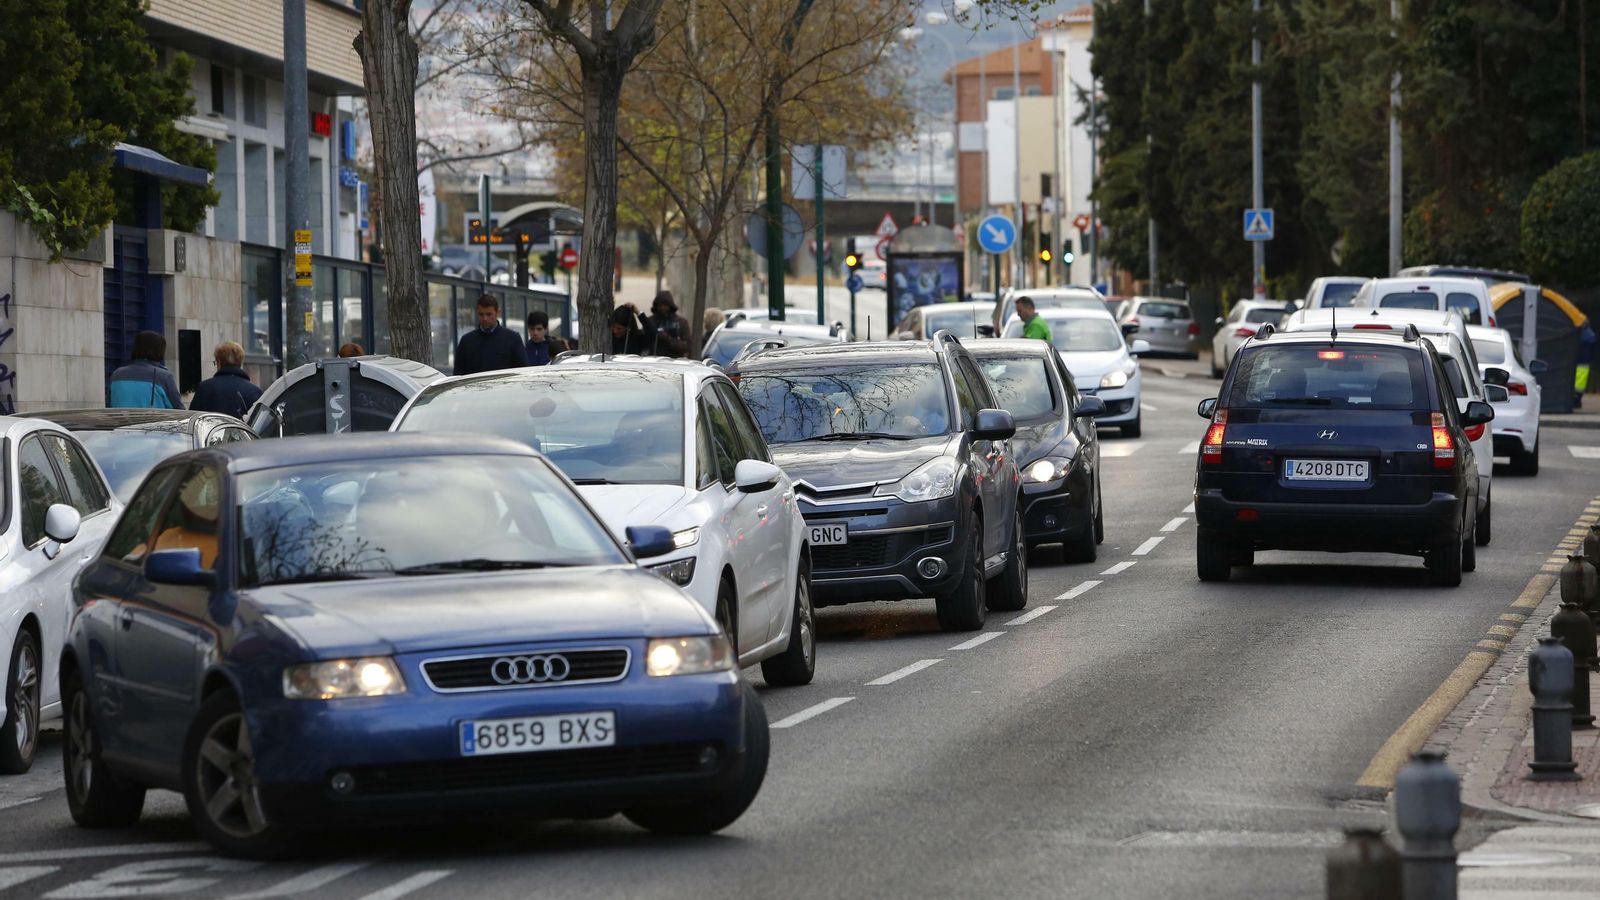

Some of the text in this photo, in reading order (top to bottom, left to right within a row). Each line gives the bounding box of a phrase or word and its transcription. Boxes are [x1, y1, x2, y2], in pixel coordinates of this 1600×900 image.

[1247, 438, 1268, 446] MATRIX
[811, 527, 842, 543] GNC
[477, 718, 609, 749] 6859 BXS
